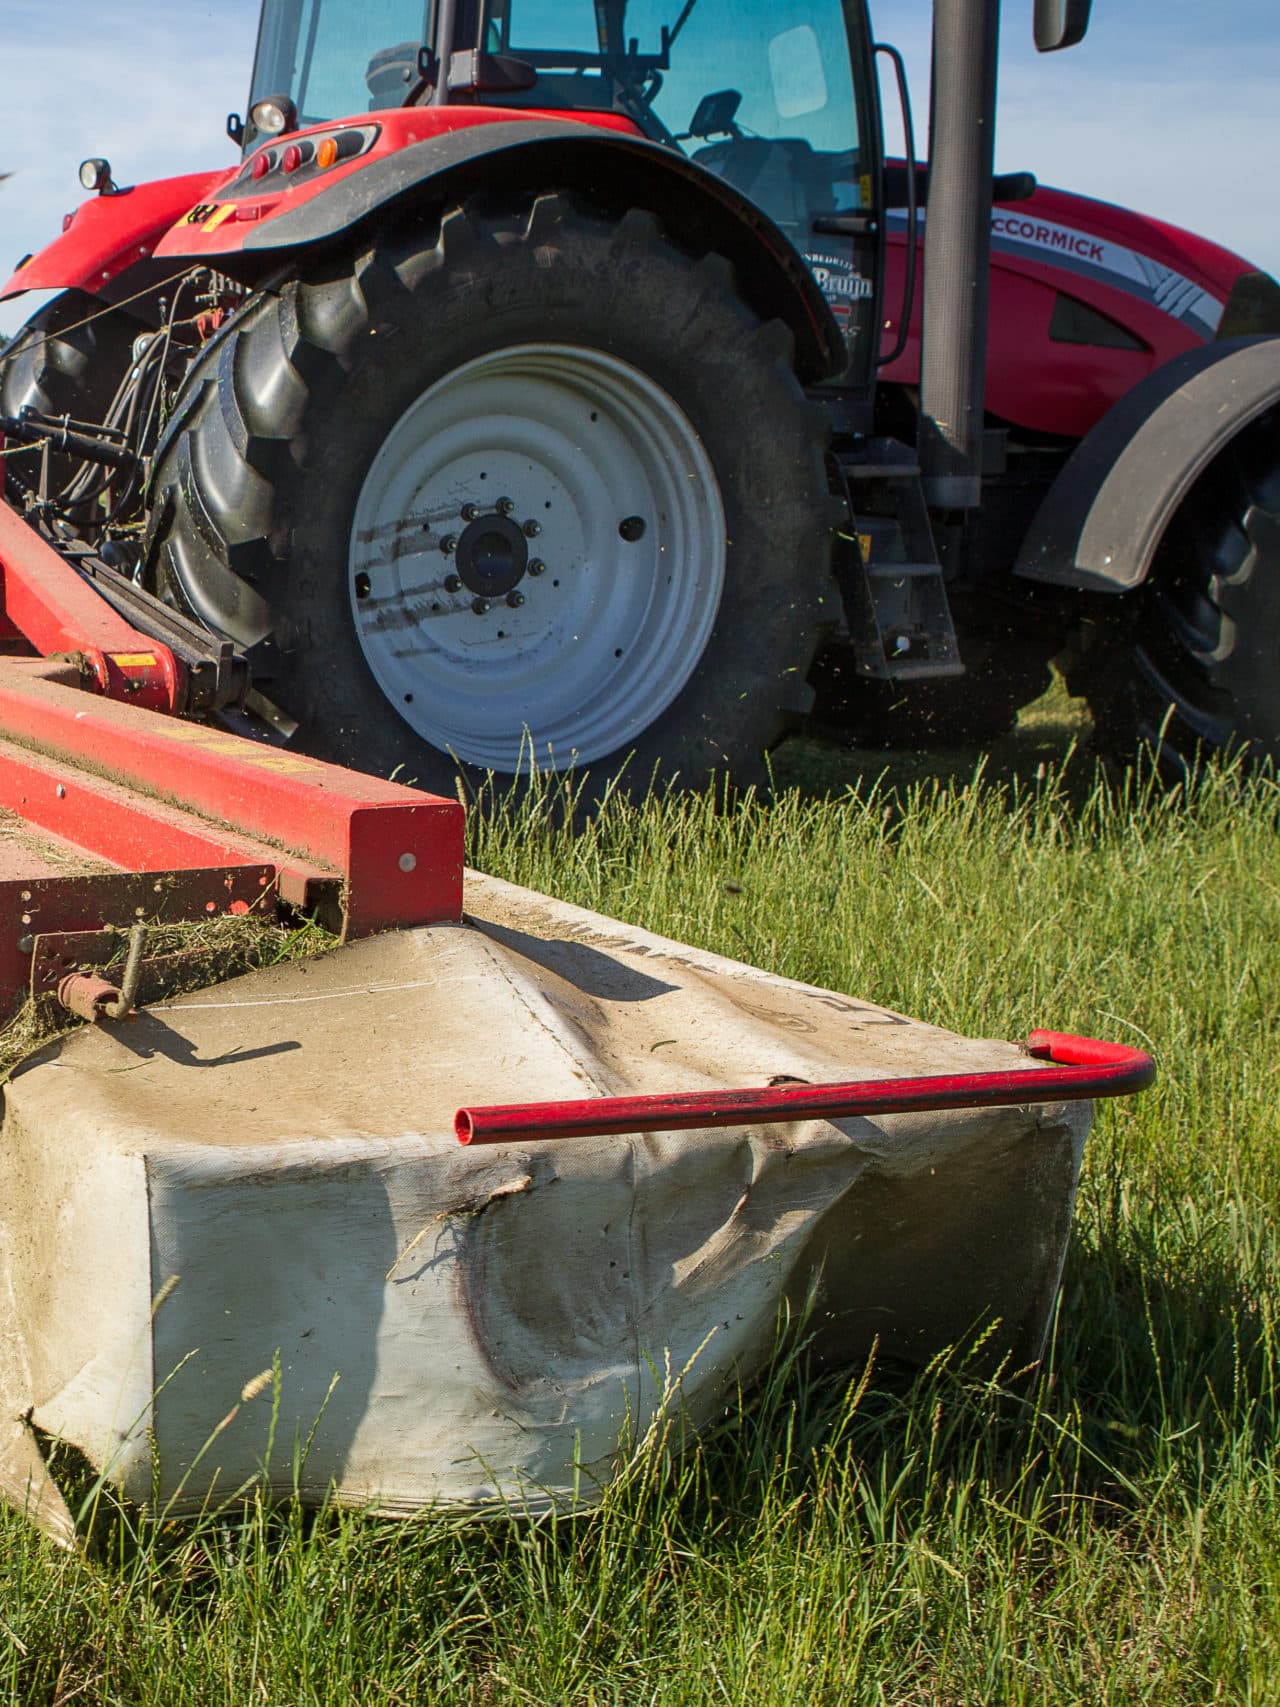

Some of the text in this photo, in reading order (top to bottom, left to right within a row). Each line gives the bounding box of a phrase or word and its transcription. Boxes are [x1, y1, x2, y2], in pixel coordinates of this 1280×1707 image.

[992, 218, 1105, 263] cCORMICK
[802, 252, 856, 271] NBEDRIJF
[812, 267, 874, 301] Bruijn
